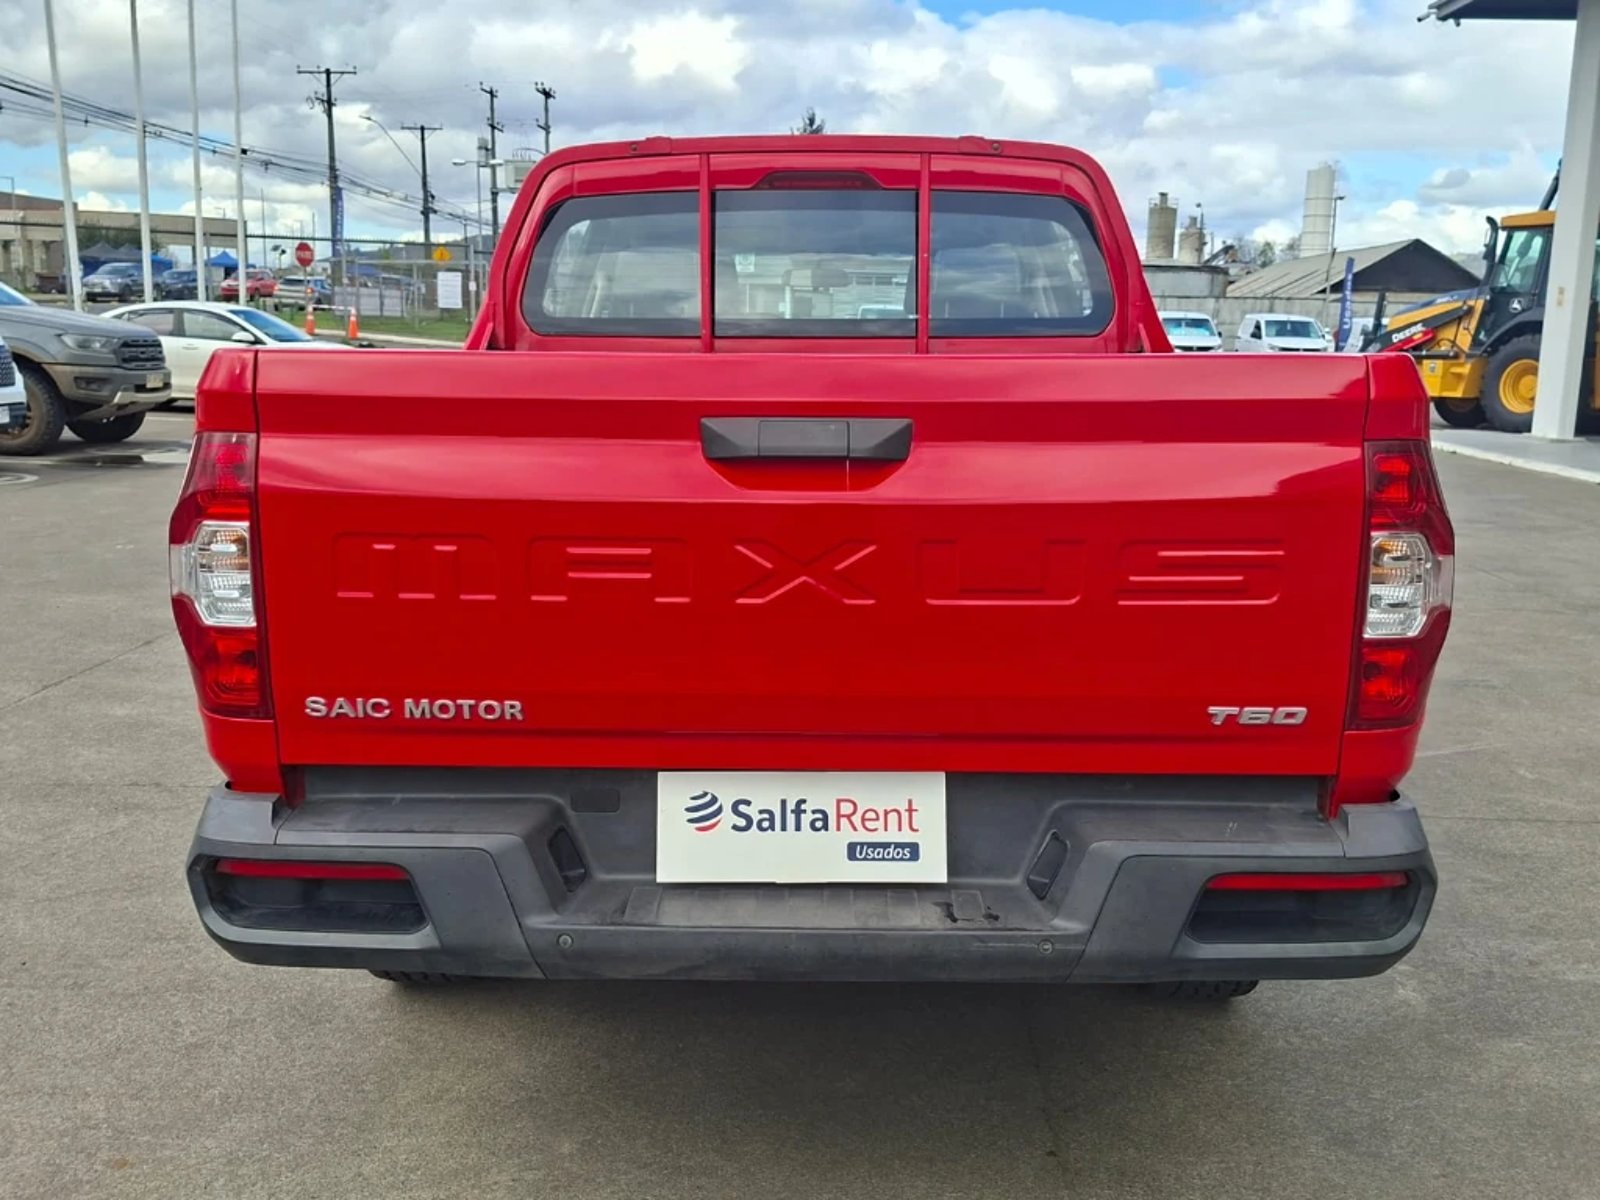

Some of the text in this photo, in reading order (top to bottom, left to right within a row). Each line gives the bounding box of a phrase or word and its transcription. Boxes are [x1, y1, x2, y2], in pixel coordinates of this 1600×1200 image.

[332, 531, 1286, 605] MAXUS
[304, 696, 524, 720] SAIC MOTOR
[1207, 705, 1308, 726] T60
[854, 844, 911, 859] Usados
